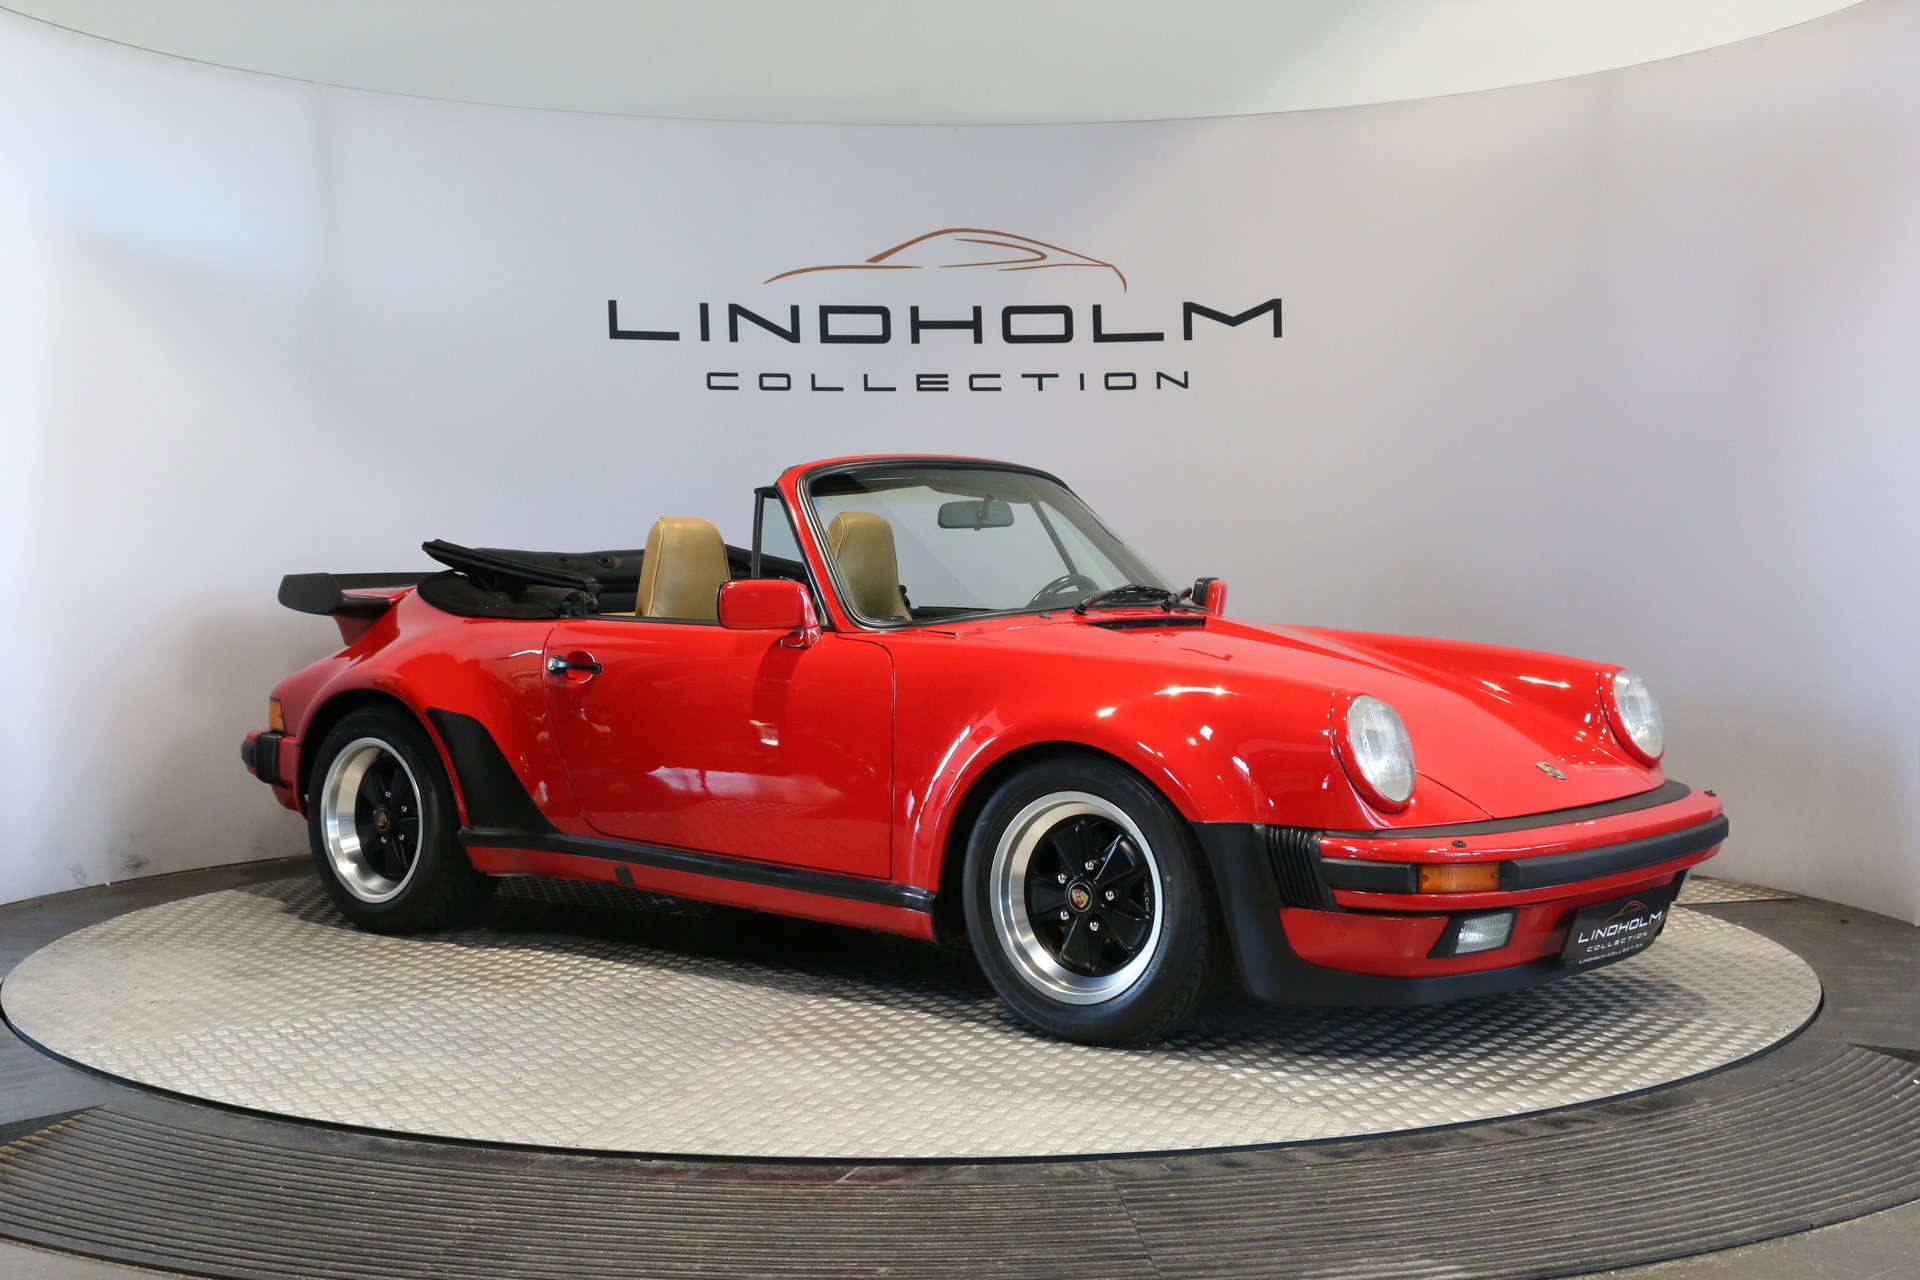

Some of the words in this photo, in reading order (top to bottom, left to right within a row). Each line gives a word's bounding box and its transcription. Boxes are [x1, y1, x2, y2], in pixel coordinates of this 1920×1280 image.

[608, 298, 1283, 345] LINDHOLM
[706, 370, 1190, 392] COLLECTION
[1577, 910, 1663, 944] LINDHOLM
[1586, 931, 1648, 953] COLLECTION
